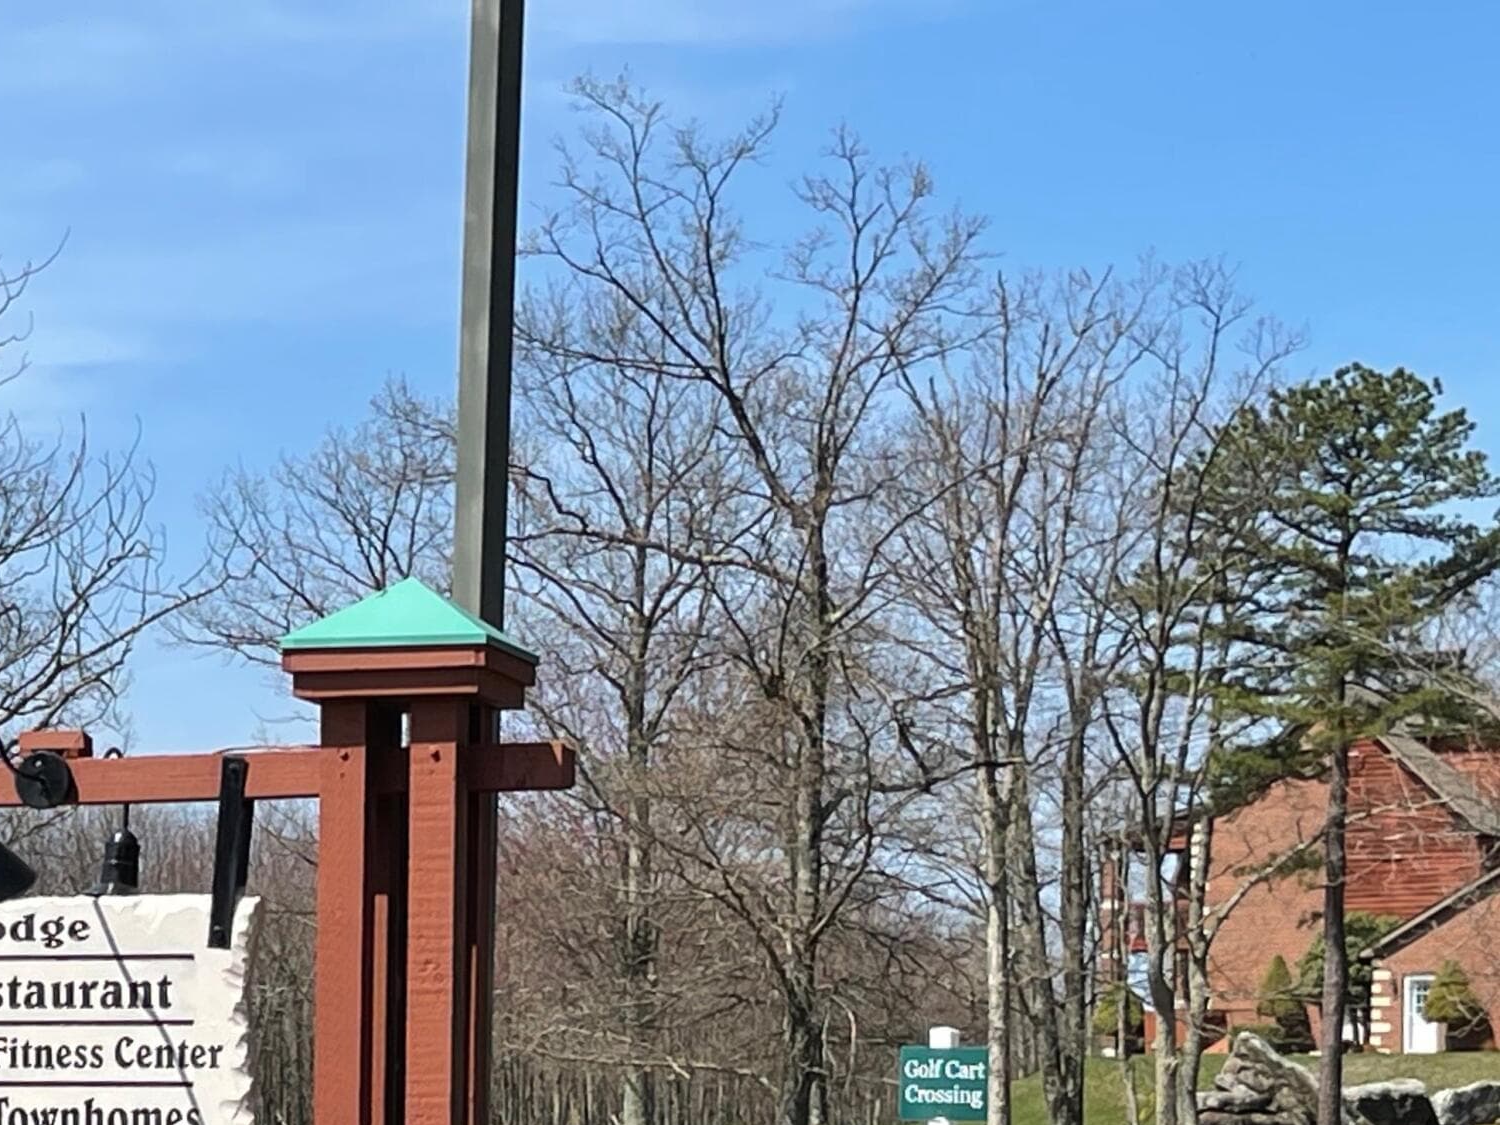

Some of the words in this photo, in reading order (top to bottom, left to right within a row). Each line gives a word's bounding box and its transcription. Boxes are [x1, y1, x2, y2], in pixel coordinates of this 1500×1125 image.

[115, 1037, 224, 1069] Center
[904, 1058, 943, 1078] Golf
[945, 1059, 985, 1079] Cart
[904, 1084, 983, 1109] Crossing
